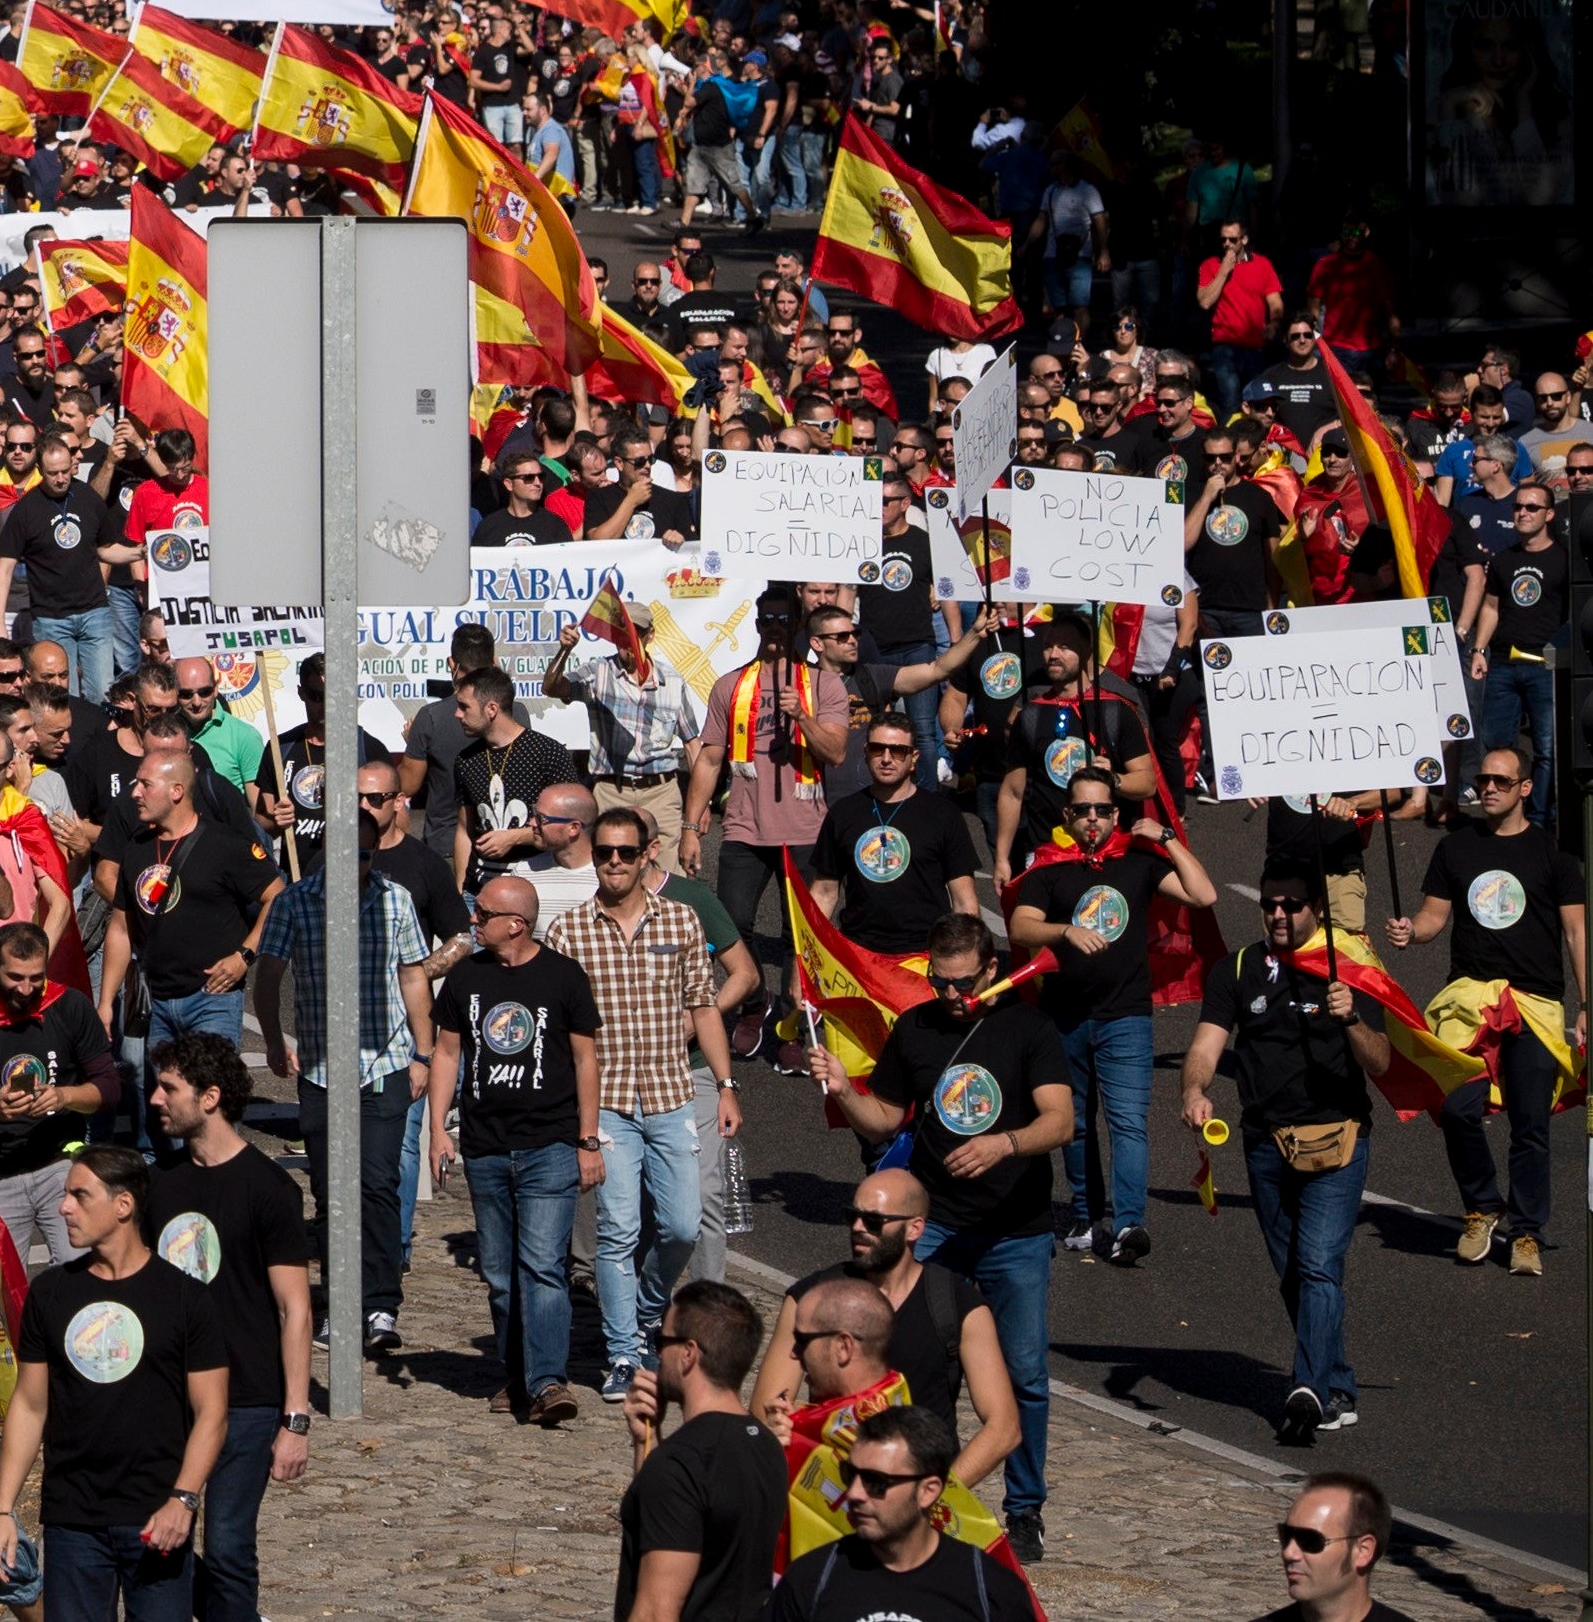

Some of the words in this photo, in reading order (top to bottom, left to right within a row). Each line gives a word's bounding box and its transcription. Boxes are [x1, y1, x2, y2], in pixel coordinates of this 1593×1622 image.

[735, 460, 862, 488] EQUIPACIÓN
[1086, 478, 1125, 500] NO
[755, 490, 882, 520] SALARIAL
[1040, 494, 1163, 534] POLICIA
[726, 530, 880, 561] DIGNIDAD
[1079, 528, 1157, 555] LOW
[469, 567, 634, 602] RABAJO,
[1049, 556, 1154, 588] COST
[206, 628, 307, 649] JUSAPOL
[357, 610, 445, 646] GUAL
[362, 657, 405, 675] ACIÓN
[411, 656, 429, 674] DE
[358, 682, 389, 700] CON
[392, 681, 428, 699] POLI
[1213, 660, 1424, 702] EQUIPARACION
[1241, 723, 1417, 766] DIGNIDAD
[532, 1006, 549, 1091] SALARIAL
[487, 1063, 526, 1088] YA!!
